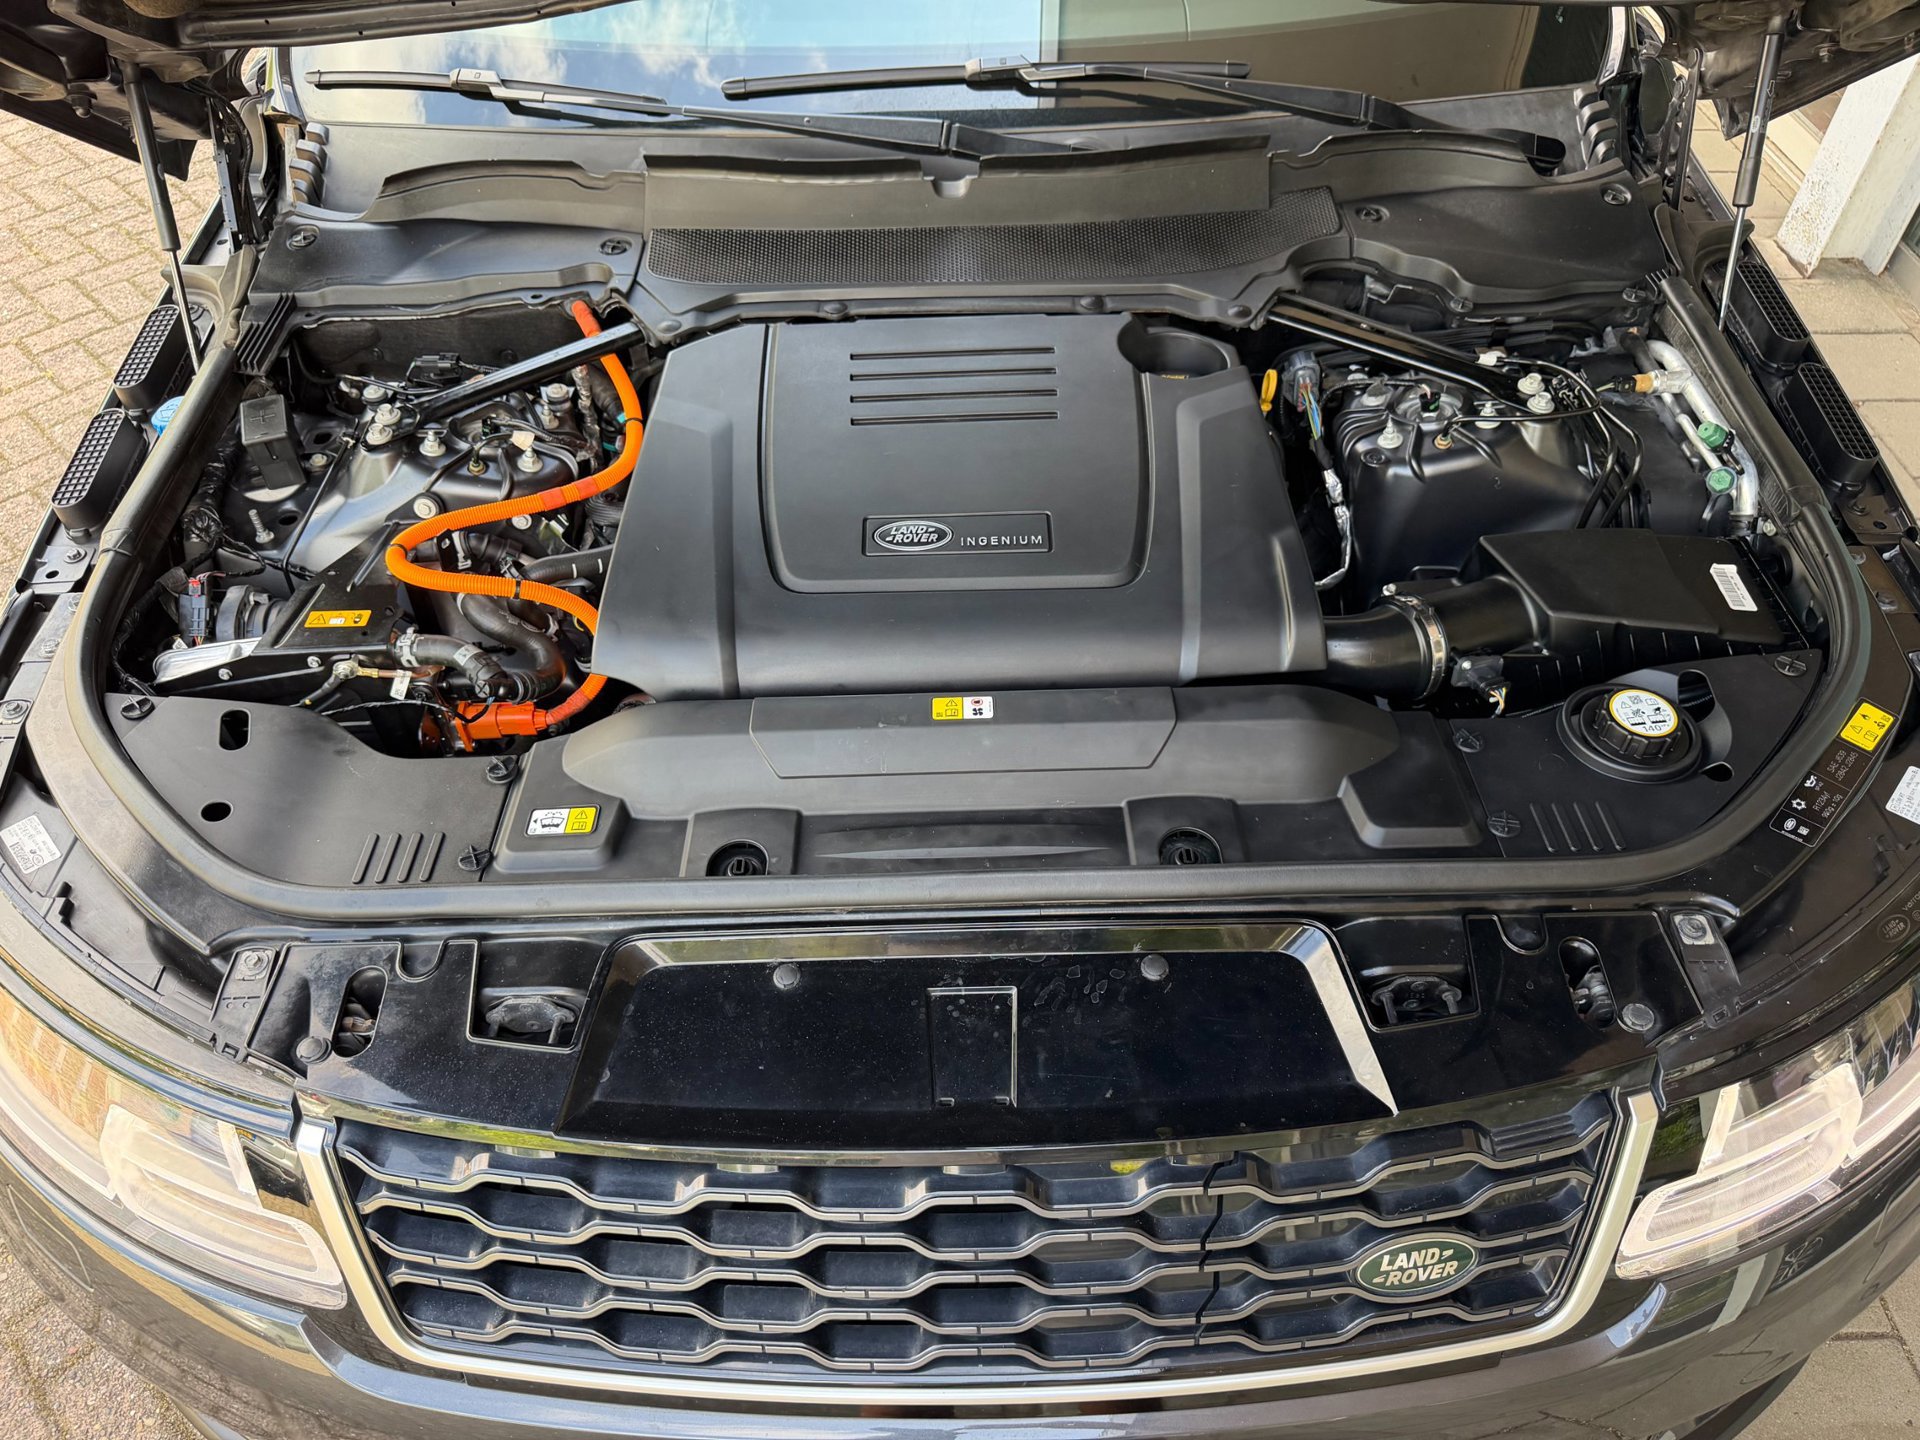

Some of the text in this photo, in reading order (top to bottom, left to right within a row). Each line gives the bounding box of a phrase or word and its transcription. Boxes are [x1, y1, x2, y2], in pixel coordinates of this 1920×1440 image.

[890, 525, 927, 534] LAND
[893, 534, 938, 543] ROVER
[960, 535, 1043, 546] INGENIUM
[1882, 920, 1897, 934] LAND
[1888, 922, 1906, 938] ROVER
[1380, 1248, 1441, 1272] LAND
[1385, 1261, 1459, 1286] ROVER
